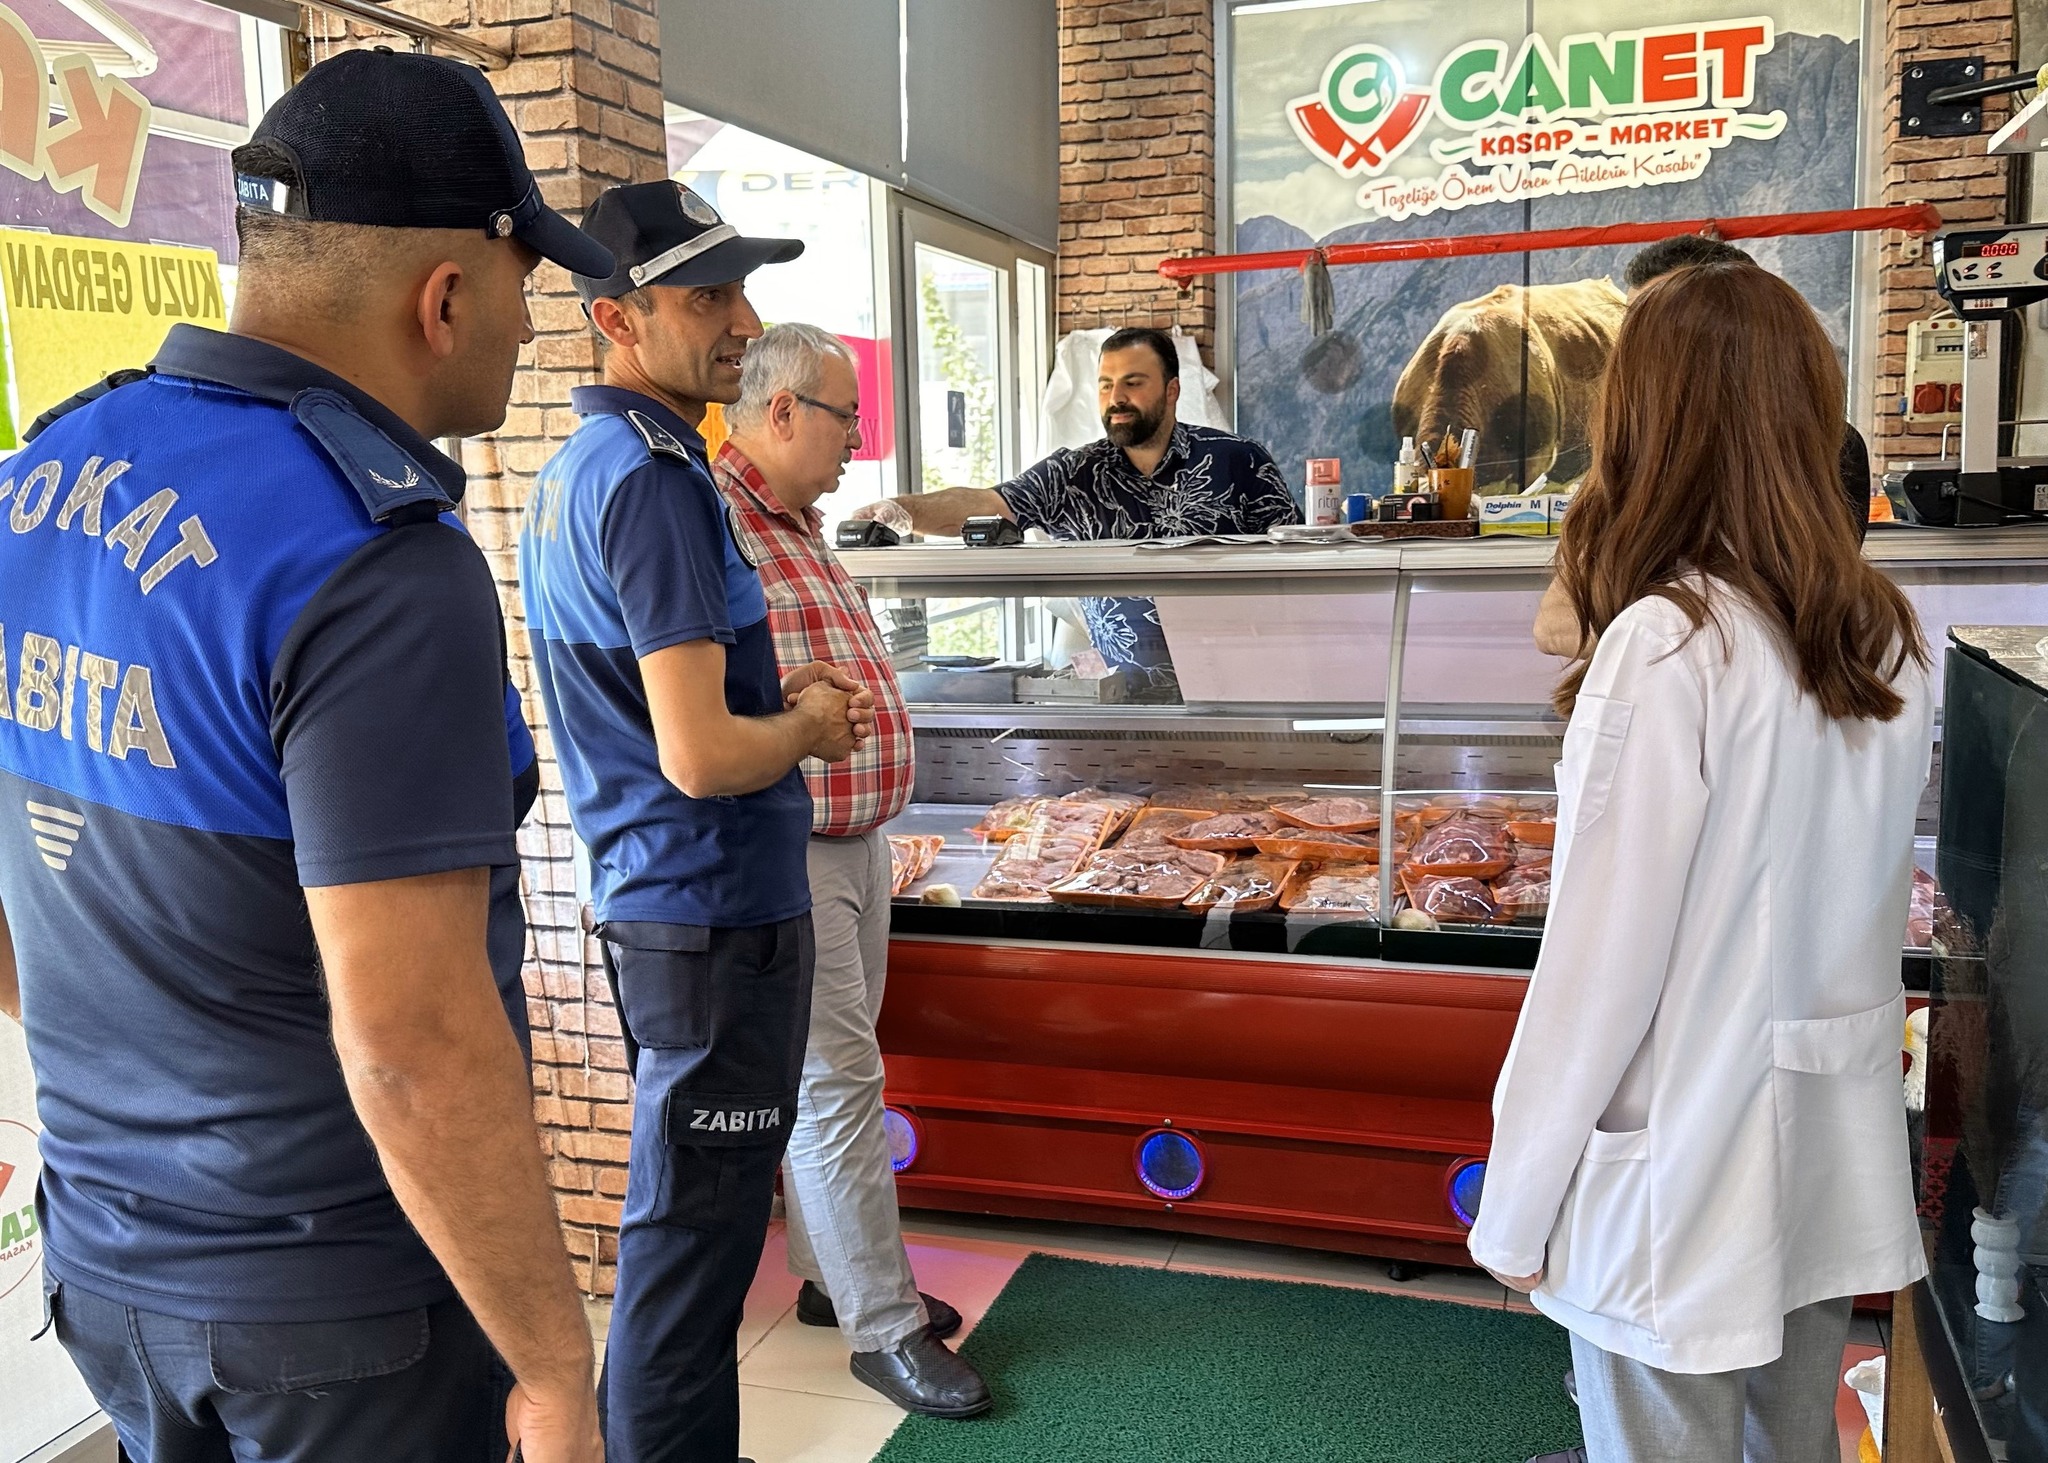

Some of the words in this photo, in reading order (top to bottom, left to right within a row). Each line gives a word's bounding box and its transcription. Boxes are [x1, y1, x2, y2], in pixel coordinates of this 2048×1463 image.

[1440, 26, 1765, 122] CANET
[1481, 129, 1574, 157] KASAP
[1610, 117, 1729, 146] MARKET
[1442, 172, 1495, 201] Önem
[1499, 168, 1551, 193] Veren
[1556, 163, 1629, 186] Ailelerin
[1981, 243, 2017, 257] 0.000
[1485, 501, 1522, 511] Dolphin
[1530, 500, 1541, 509] M
[690, 1107, 780, 1132] ZABITA
